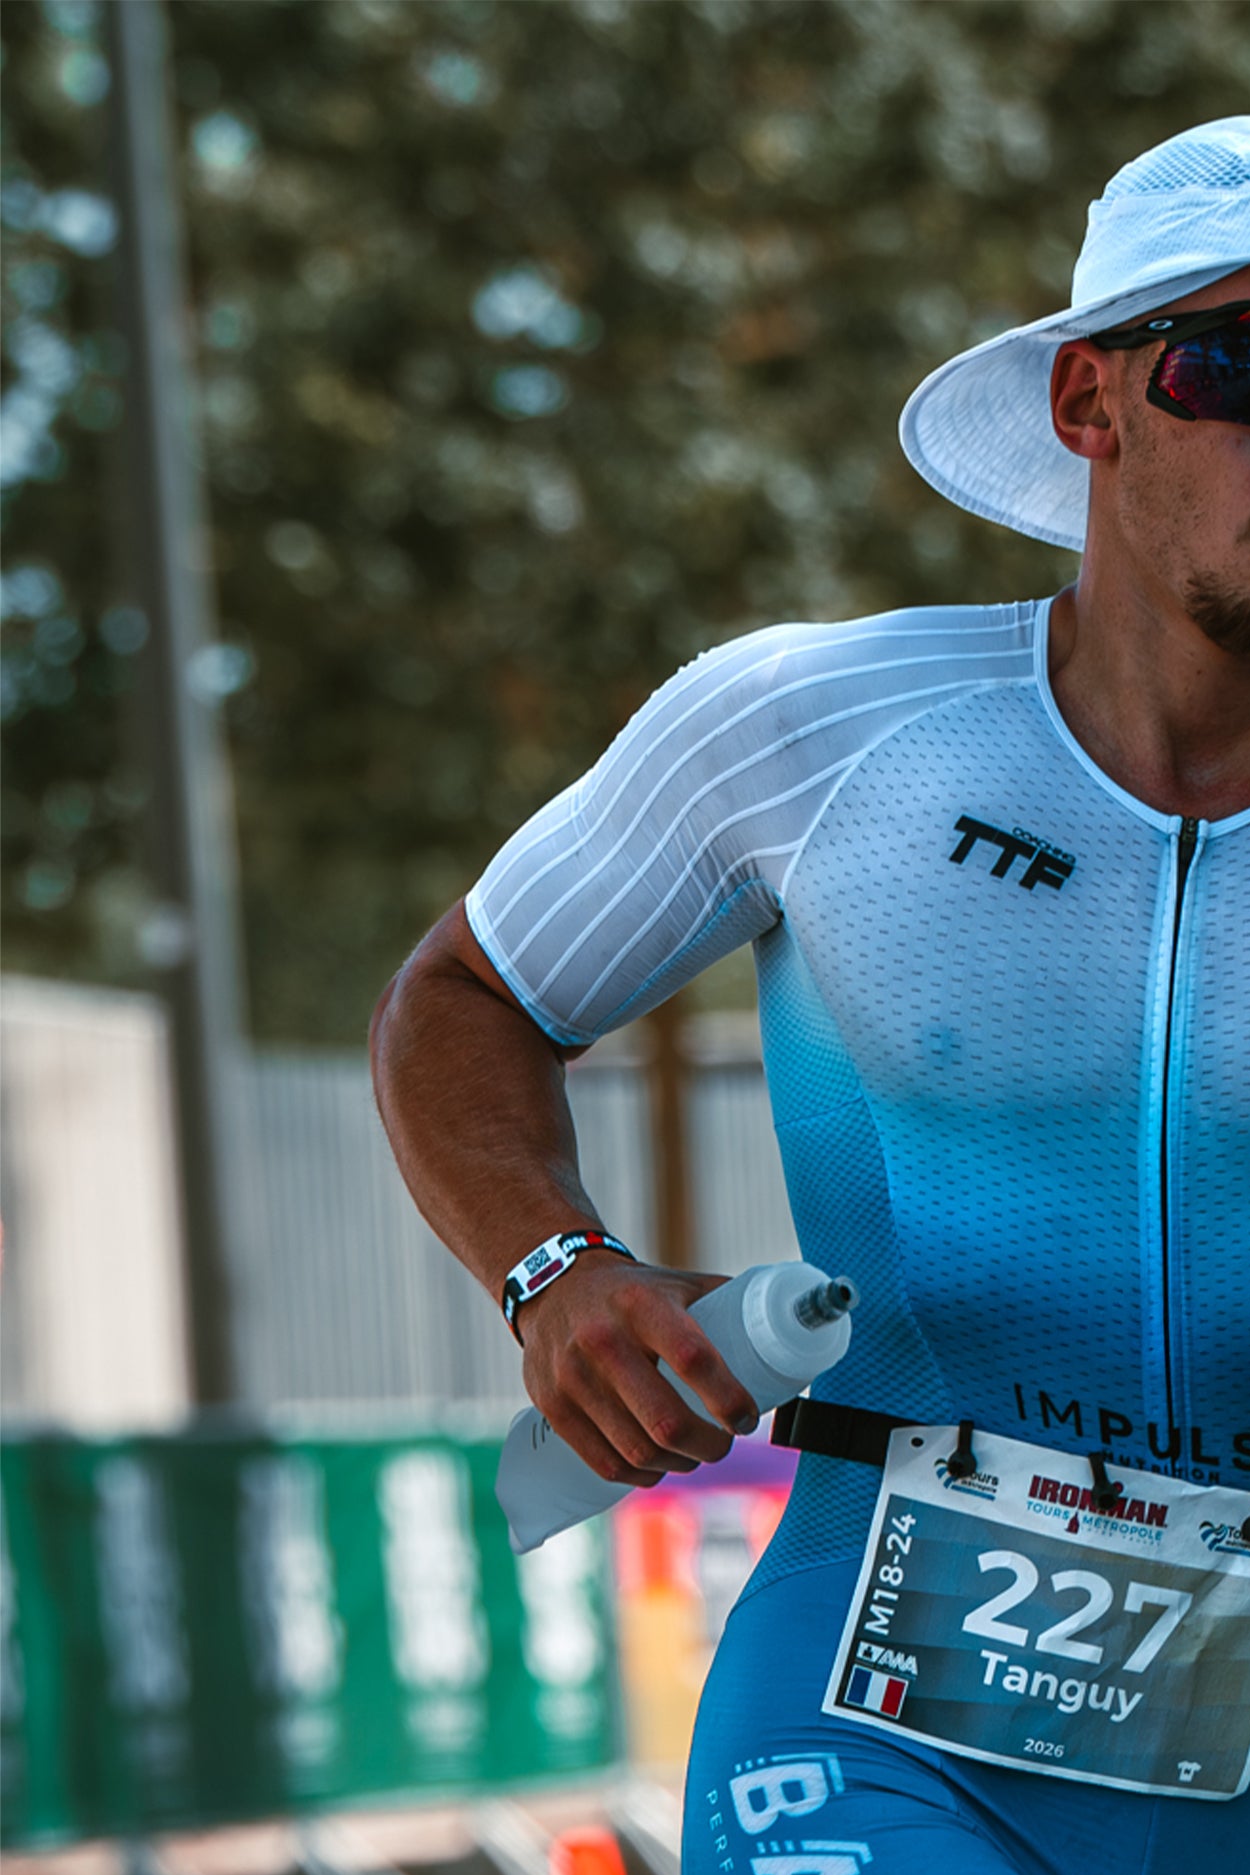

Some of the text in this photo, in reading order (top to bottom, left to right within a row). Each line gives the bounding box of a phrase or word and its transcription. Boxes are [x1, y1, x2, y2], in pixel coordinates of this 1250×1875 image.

[949, 814, 1077, 891] TTF
[1026, 1501, 1069, 1521] TOURS
[864, 1514, 916, 1636] M18-24
[962, 1550, 1193, 1674] 227
[980, 1649, 1144, 1723] Tanguy
[1024, 1738, 1065, 1758] 2026
